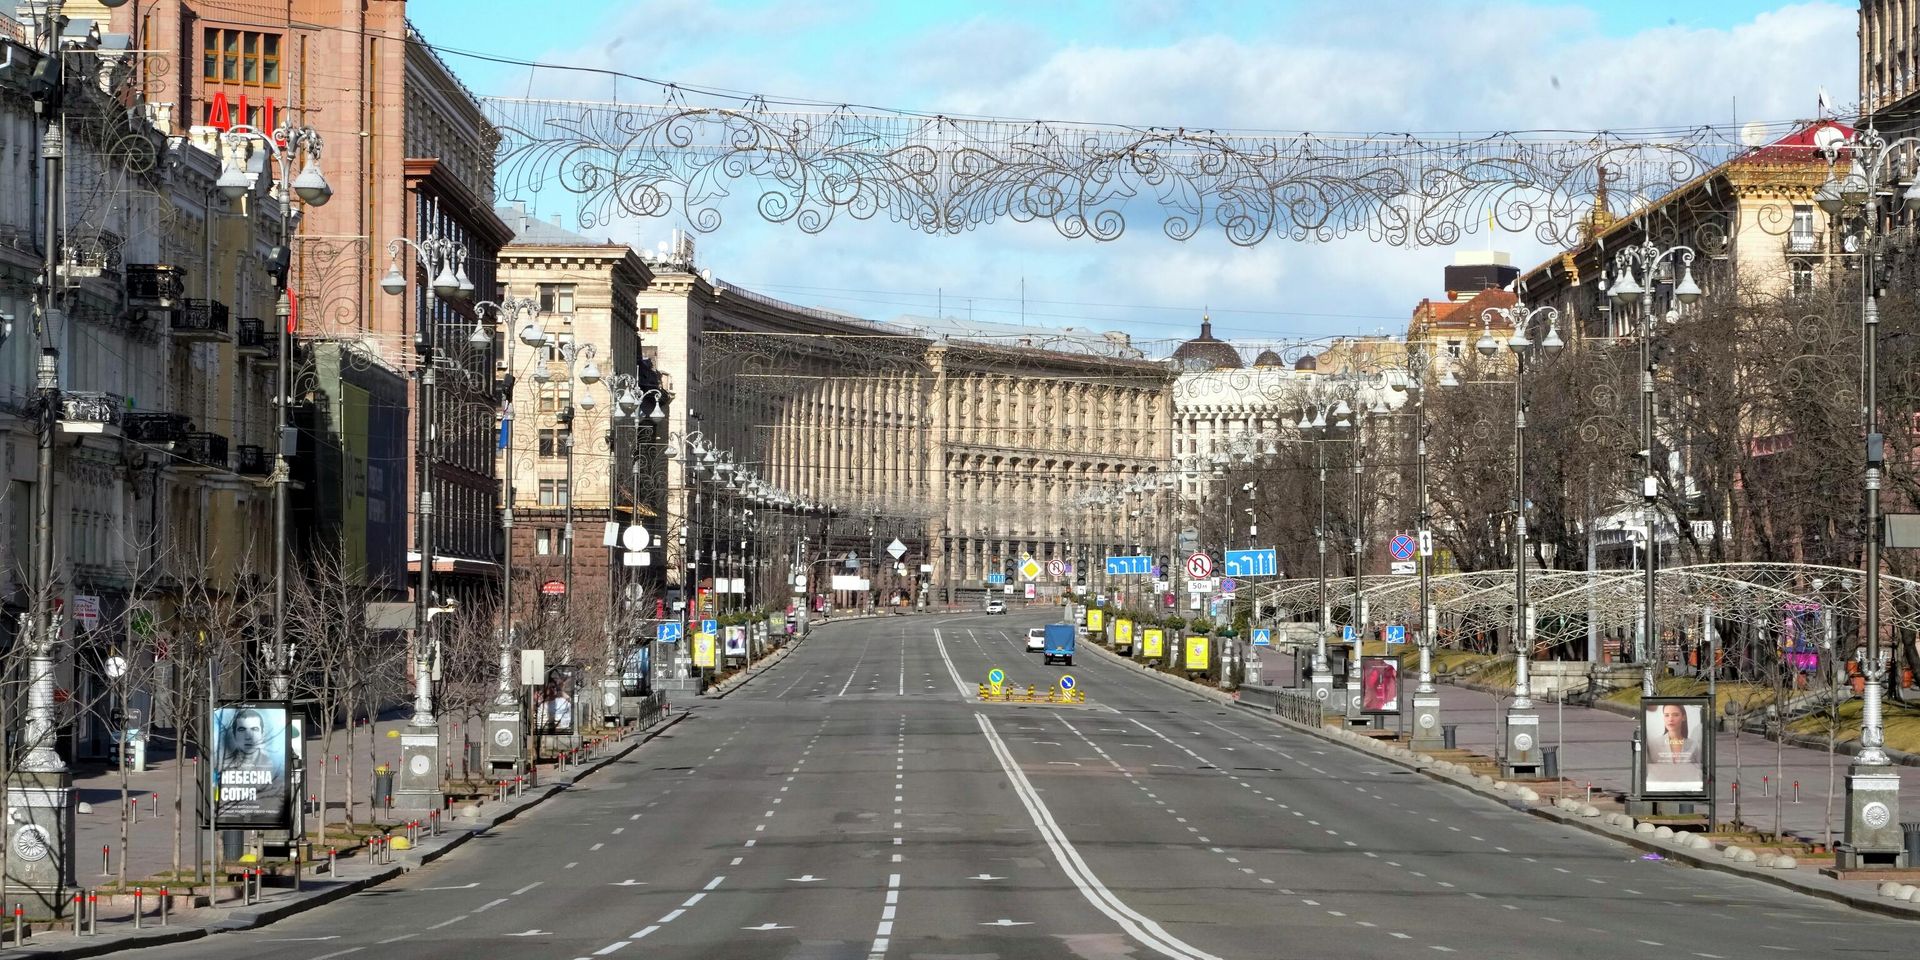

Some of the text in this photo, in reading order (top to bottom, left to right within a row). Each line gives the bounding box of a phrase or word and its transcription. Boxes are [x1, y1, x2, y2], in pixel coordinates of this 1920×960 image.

[1192, 582, 1202, 590] 50
[221, 770, 272, 785] НЕБЕСНА
[220, 787, 256, 801] СОТНЯ
